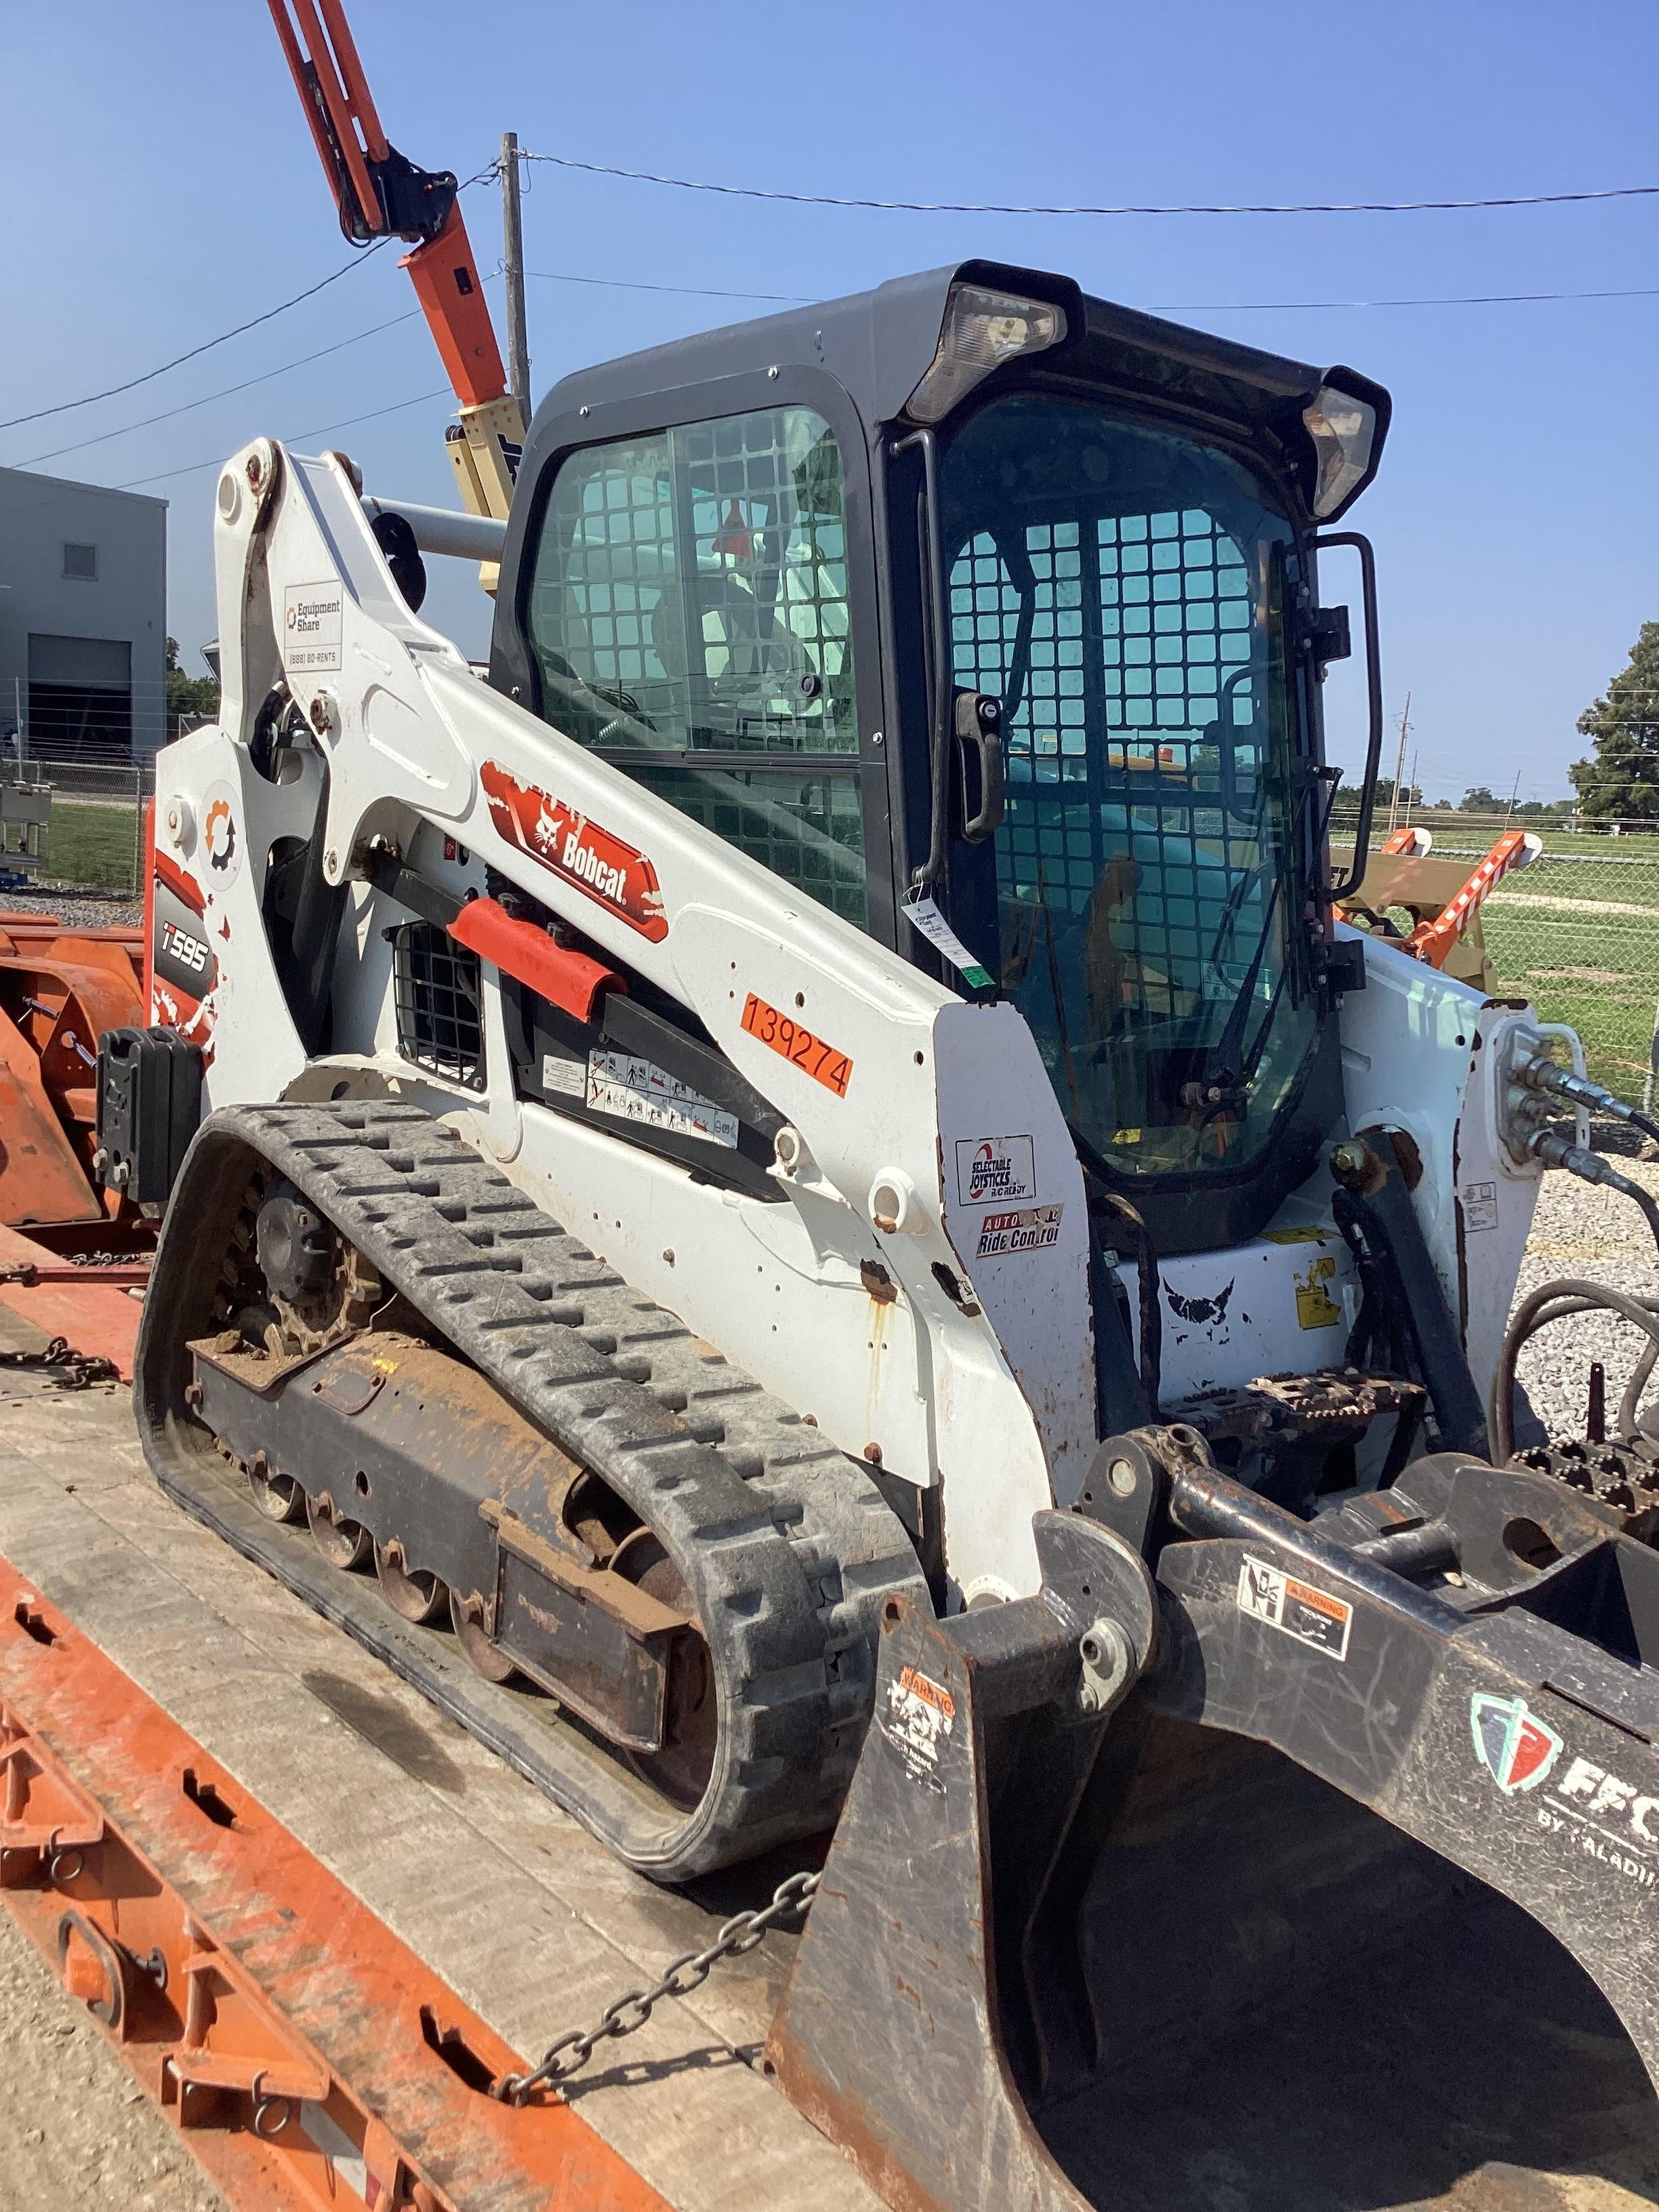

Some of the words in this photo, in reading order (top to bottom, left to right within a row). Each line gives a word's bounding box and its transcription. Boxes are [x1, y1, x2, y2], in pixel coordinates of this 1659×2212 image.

[298, 599, 340, 618] Equipment
[297, 618, 321, 632] Share
[289, 653, 306, 665] (888)
[562, 832, 627, 905] Bobcat
[163, 920, 209, 972] T595
[748, 998, 848, 1093] 139274
[972, 1158, 1011, 1174] SELECTABLE
[970, 1171, 1010, 1190] JOYSTICKS
[978, 1232, 1008, 1254] Ride
[1536, 1807, 1565, 1832] BY
